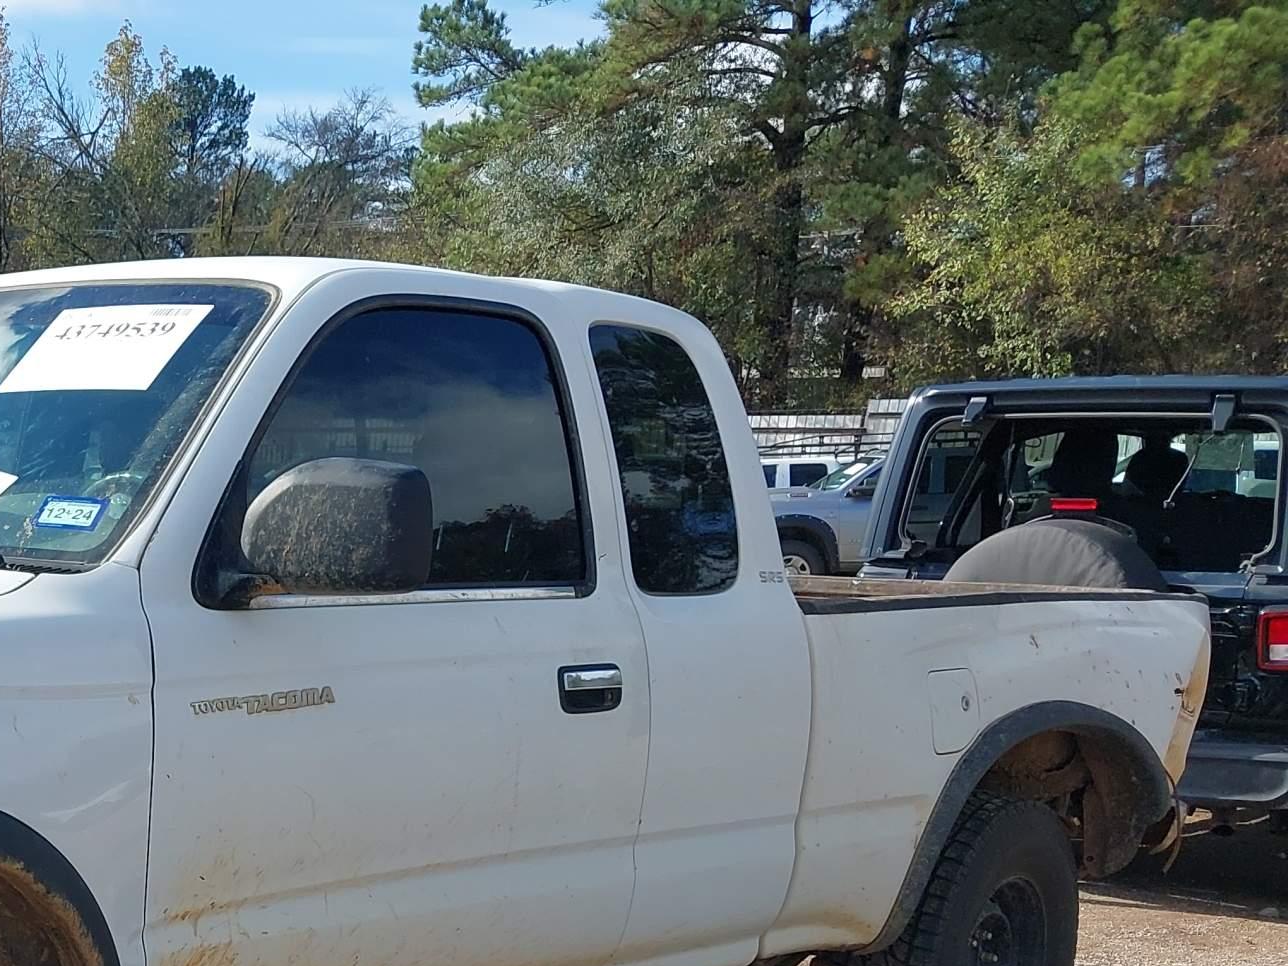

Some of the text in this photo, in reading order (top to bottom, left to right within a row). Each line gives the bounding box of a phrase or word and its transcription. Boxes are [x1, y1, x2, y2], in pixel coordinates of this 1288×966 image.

[55, 321, 177, 340] 43749539
[758, 571, 784, 583] SR5
[190, 686, 335, 715] TOYOTA TACOMA
